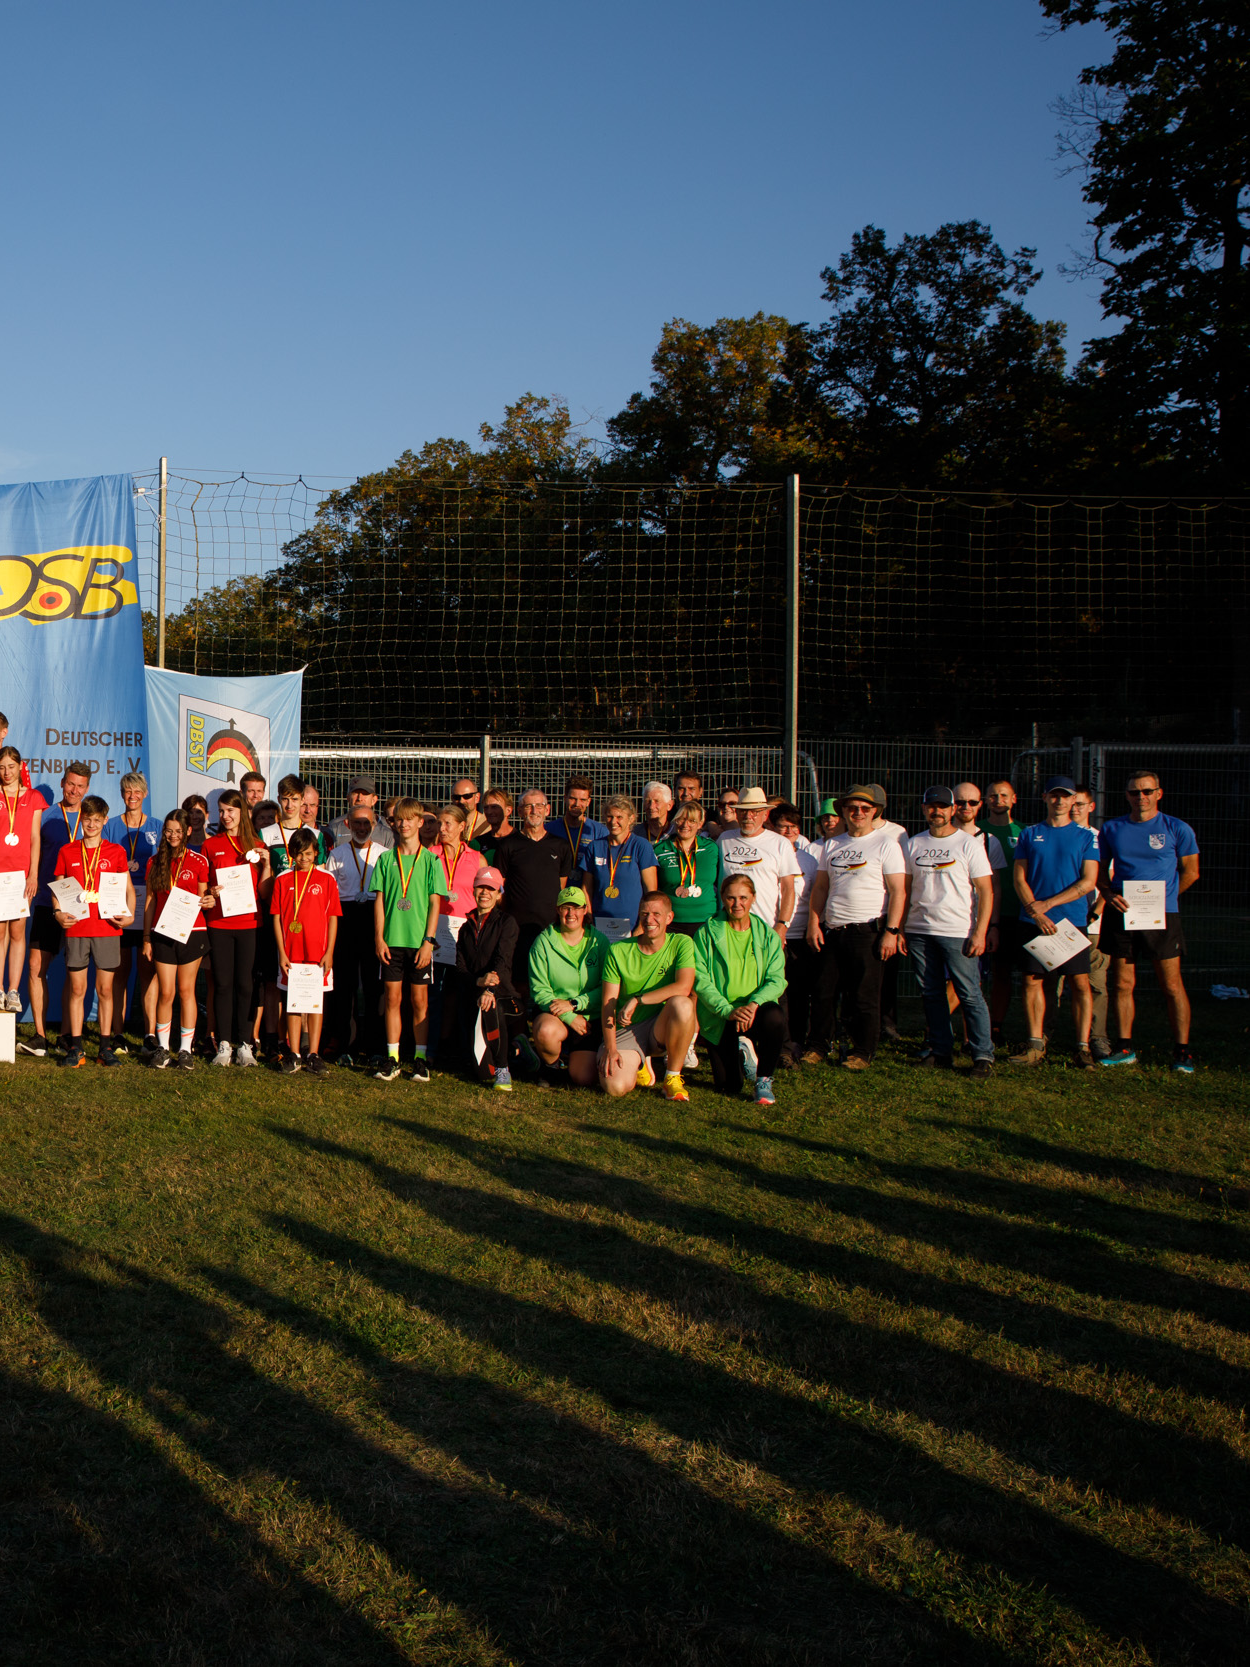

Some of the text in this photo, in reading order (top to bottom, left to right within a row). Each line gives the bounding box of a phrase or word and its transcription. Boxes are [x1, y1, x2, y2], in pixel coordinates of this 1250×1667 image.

[46, 728, 143, 747] DEUTSCHER
[189, 714, 205, 772] DBSV
[107, 759, 121, 775] E.
[732, 846, 758, 857] 2024
[837, 850, 863, 860] 2024
[922, 848, 950, 859] 2024
